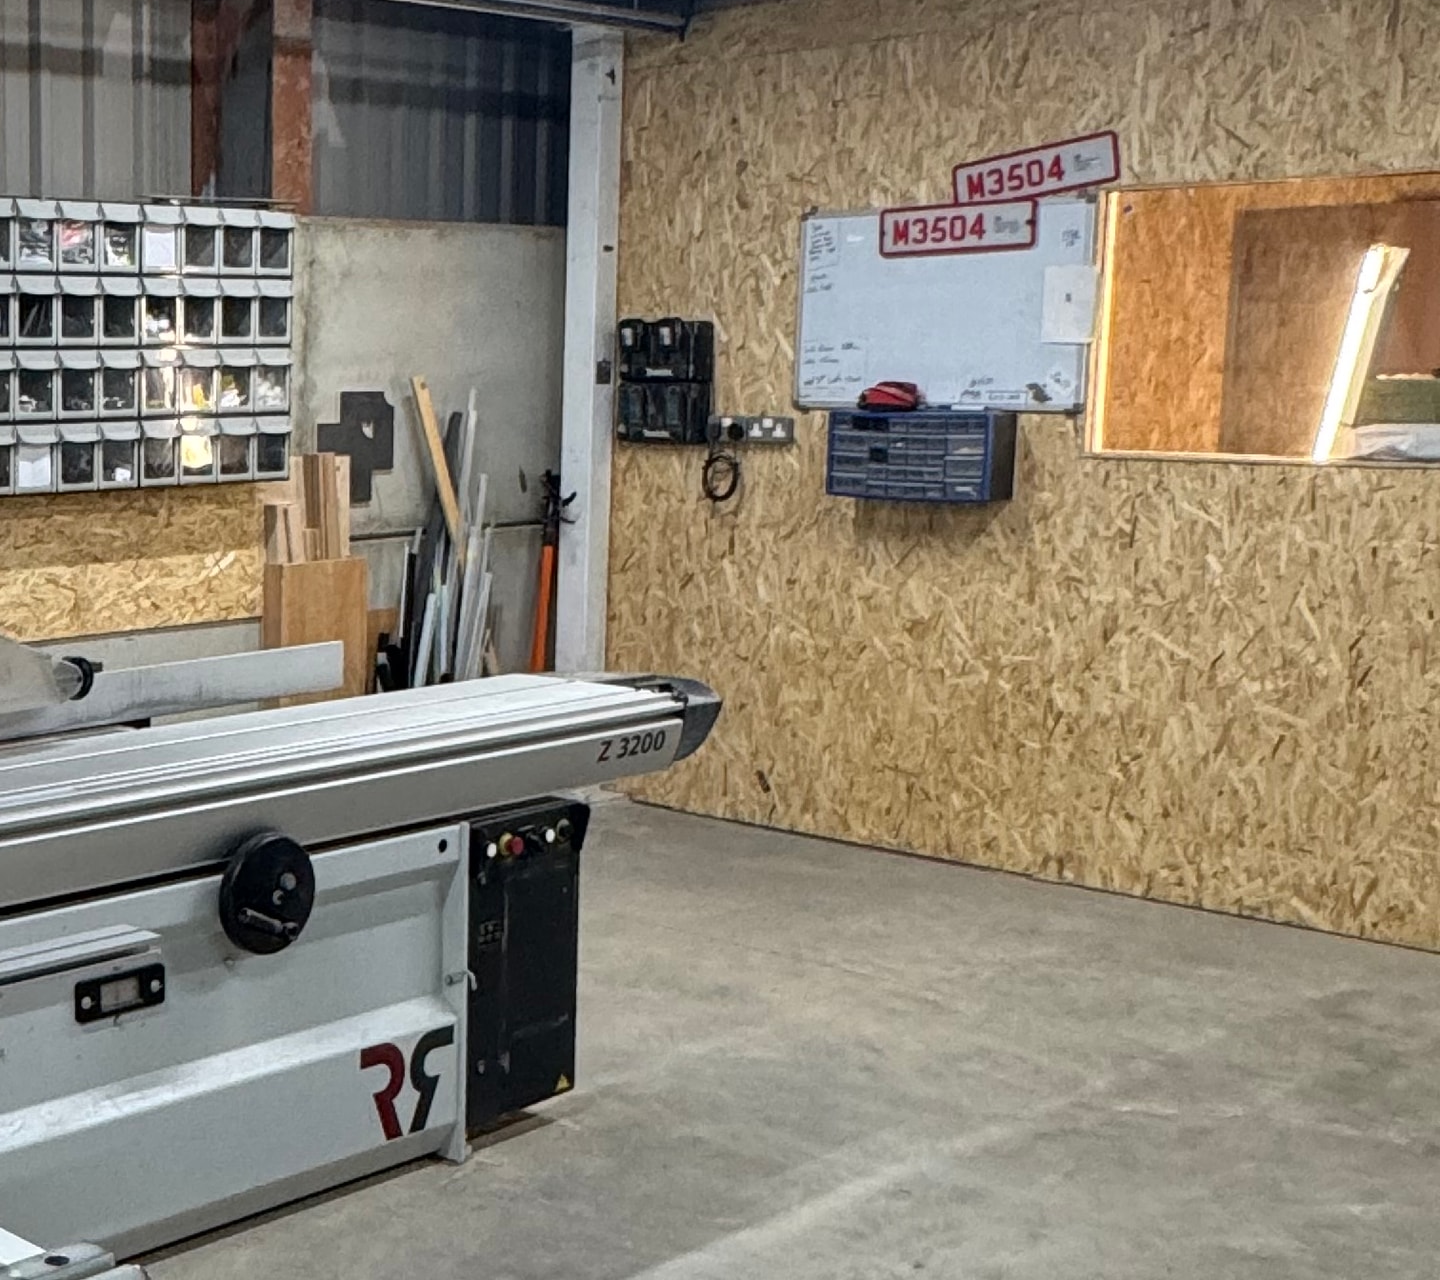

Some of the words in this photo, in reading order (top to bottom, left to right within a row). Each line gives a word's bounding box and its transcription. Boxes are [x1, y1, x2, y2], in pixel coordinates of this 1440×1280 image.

[966, 154, 1065, 201] M3504
[892, 212, 987, 246] M3504
[596, 740, 613, 763] Z
[616, 730, 666, 759] 3200
